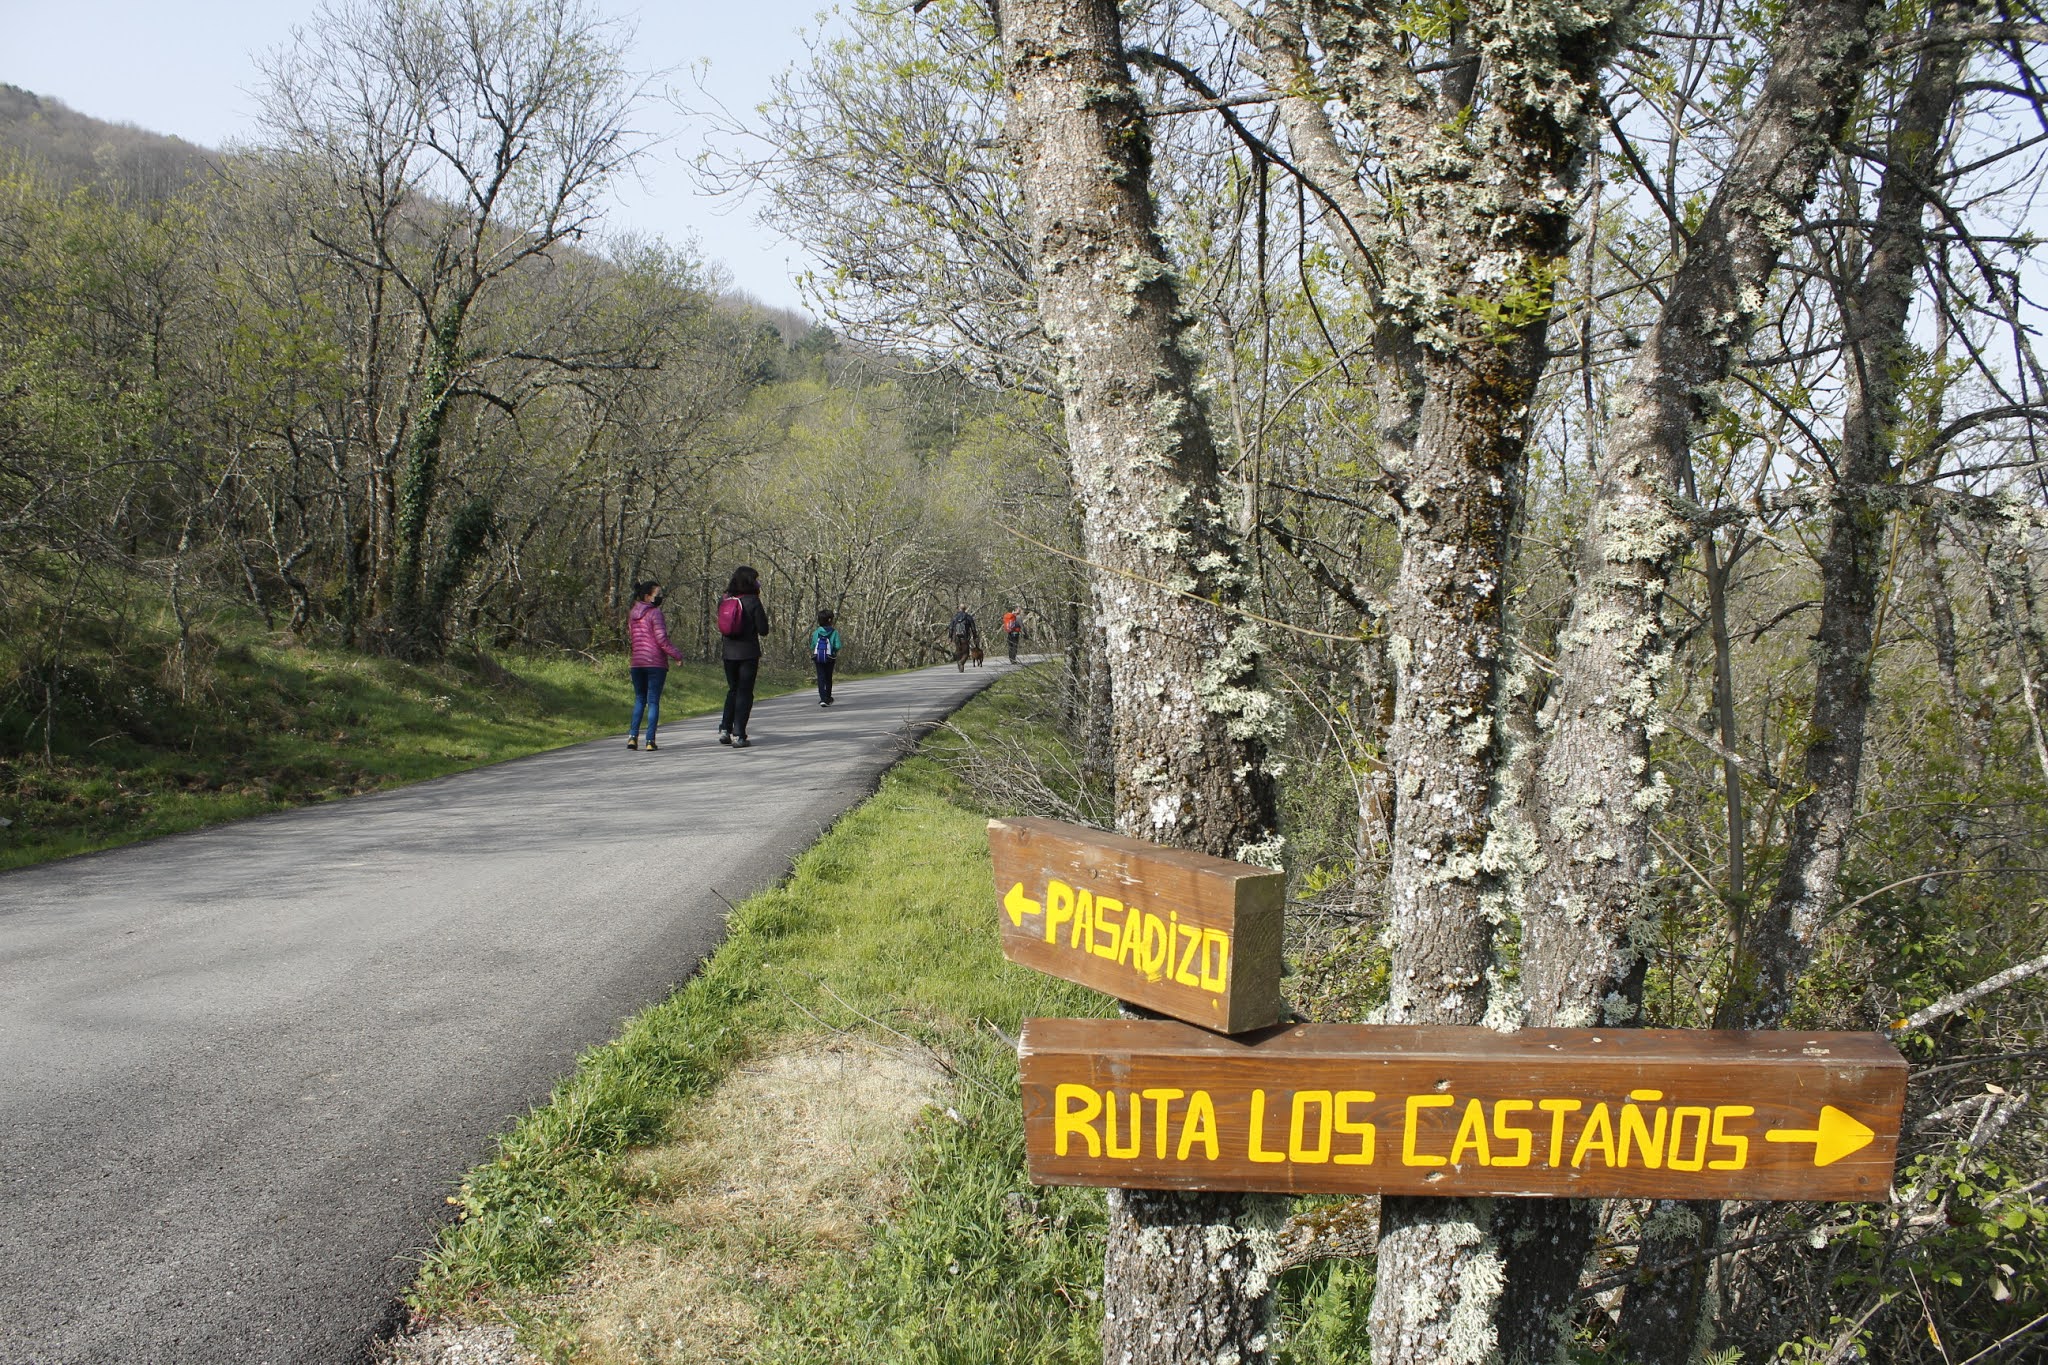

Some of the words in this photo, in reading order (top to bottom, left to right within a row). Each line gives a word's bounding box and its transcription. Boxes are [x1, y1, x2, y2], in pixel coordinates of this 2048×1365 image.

[1055, 1083, 1220, 1161] RUTA
[1248, 1088, 1376, 1165] LOS
[1402, 1089, 1755, 1172] CASTAÑOS
